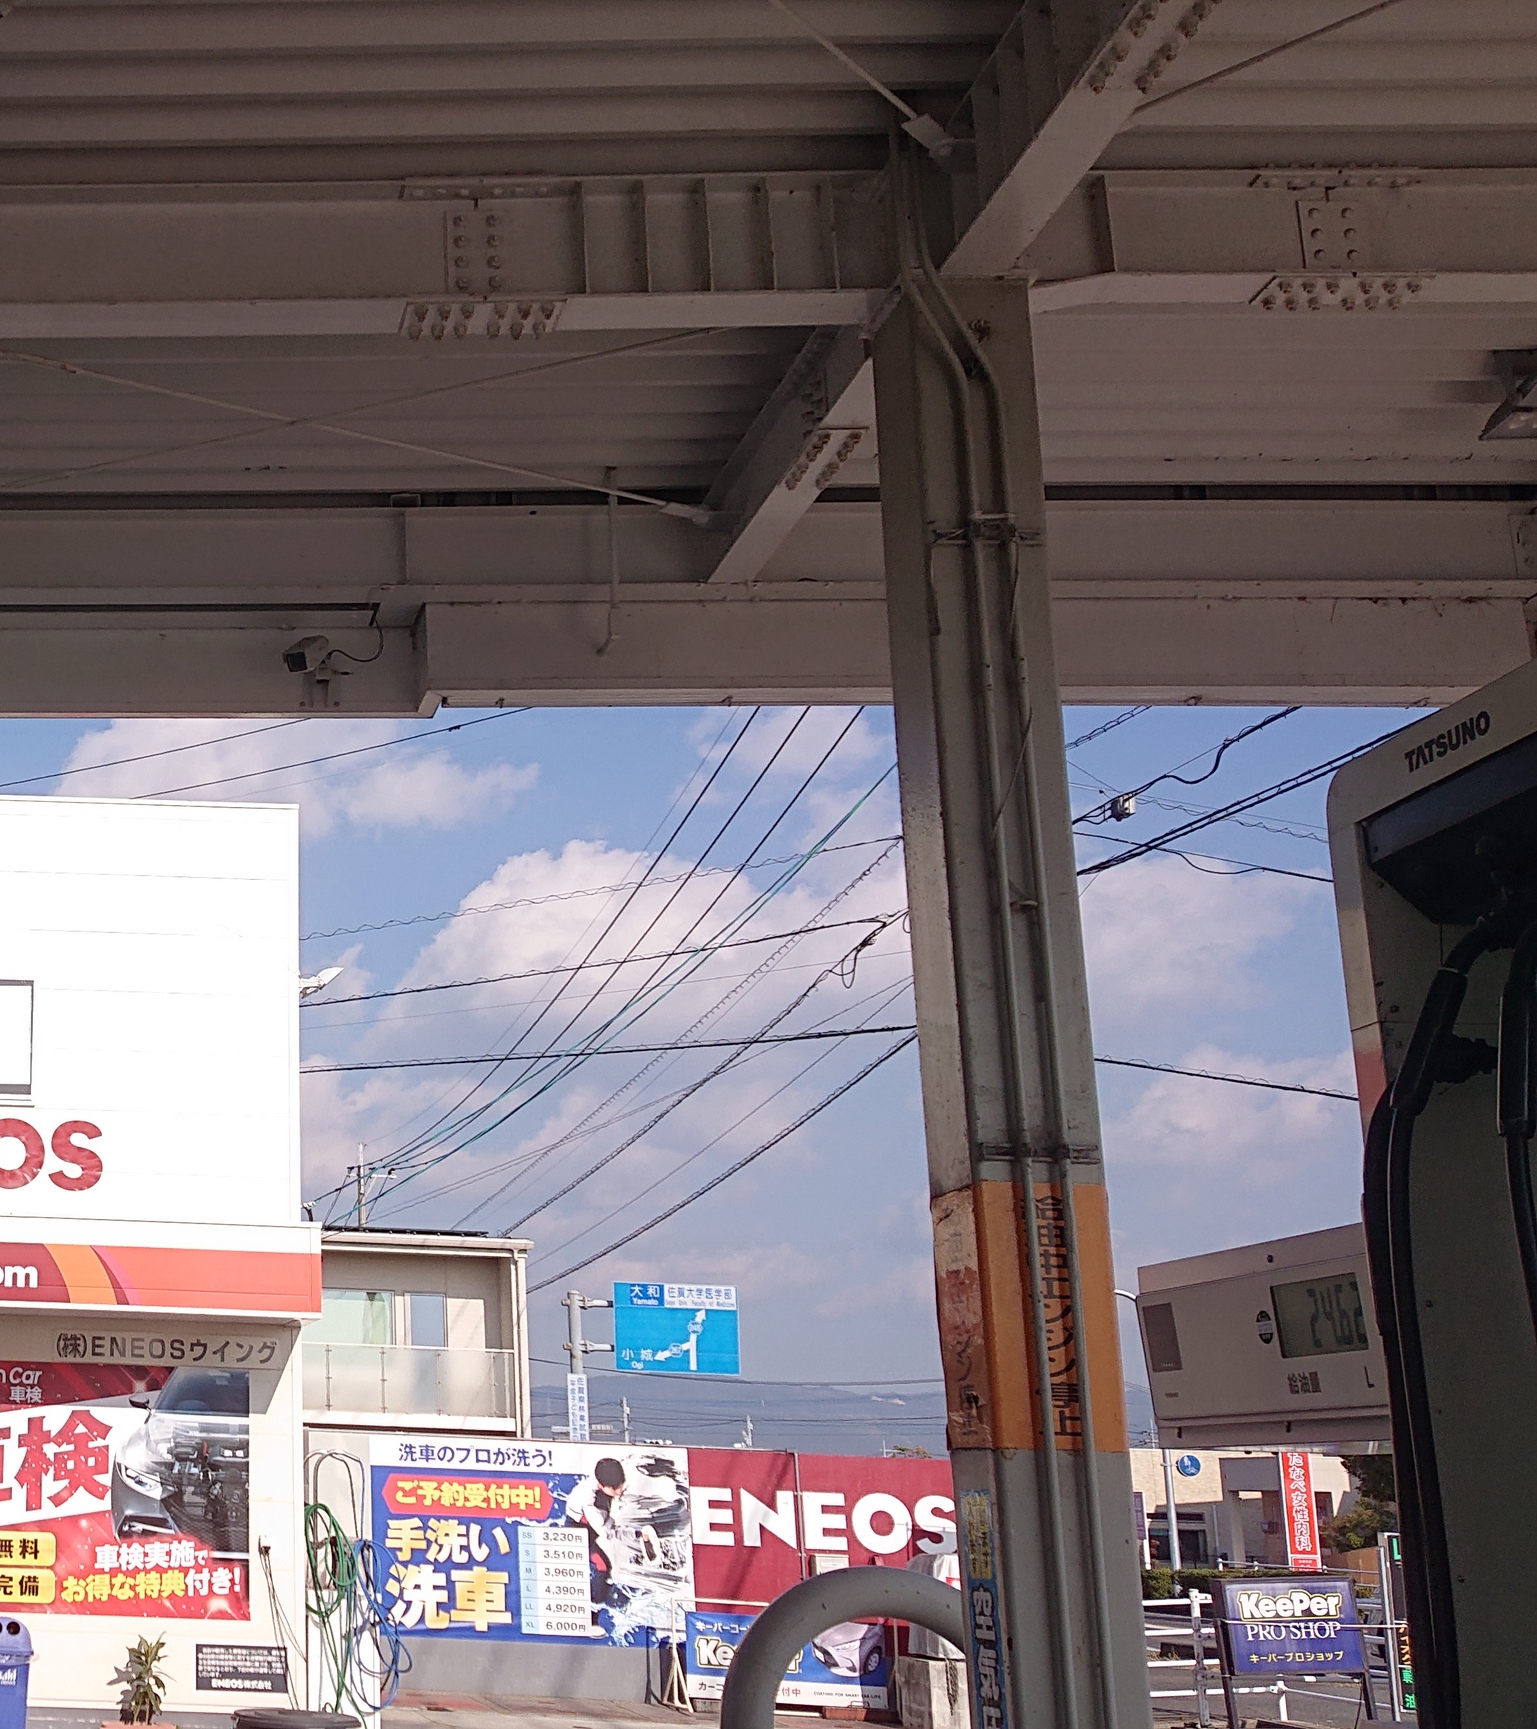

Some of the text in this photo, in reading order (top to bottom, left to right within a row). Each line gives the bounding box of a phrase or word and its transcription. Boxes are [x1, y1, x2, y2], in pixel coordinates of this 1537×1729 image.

[1404, 710, 1491, 774] TATSUNO
[630, 1284, 660, 1298] 大和
[632, 1297, 659, 1306] Yamato
[667, 1287, 733, 1300] 佐賀大学医学部
[9, 1366, 42, 1385] Car
[1287, 1371, 1322, 1395] 給油量
[1363, 1365, 1375, 1389] L
[9, 1385, 42, 1403] 車検
[398, 1442, 553, 1468] 洗車のプロが洗う!
[395, 1480, 542, 1510] ご予約受付中!
[1287, 1452, 1312, 1551] たなべ女性内科
[689, 1486, 957, 1555] ENEOS
[384, 1516, 511, 1564] 手洗い
[521, 1531, 583, 1544] SS 3,230円
[94, 1540, 209, 1573] 車検実施で
[524, 1549, 531, 1558] S
[525, 1566, 584, 1579] M 3,960円
[60, 1566, 242, 1603] お得な特典付き!
[526, 1585, 585, 1598] L 4,390円
[384, 1564, 513, 1632] 洗車
[1239, 1591, 1341, 1620] KeePer
[525, 1603, 586, 1615] LL 4,920円
[525, 1620, 586, 1633] XL 6,000円
[695, 1620, 751, 1634] キーパーコー
[1245, 1620, 1341, 1641] PRO SHOP
